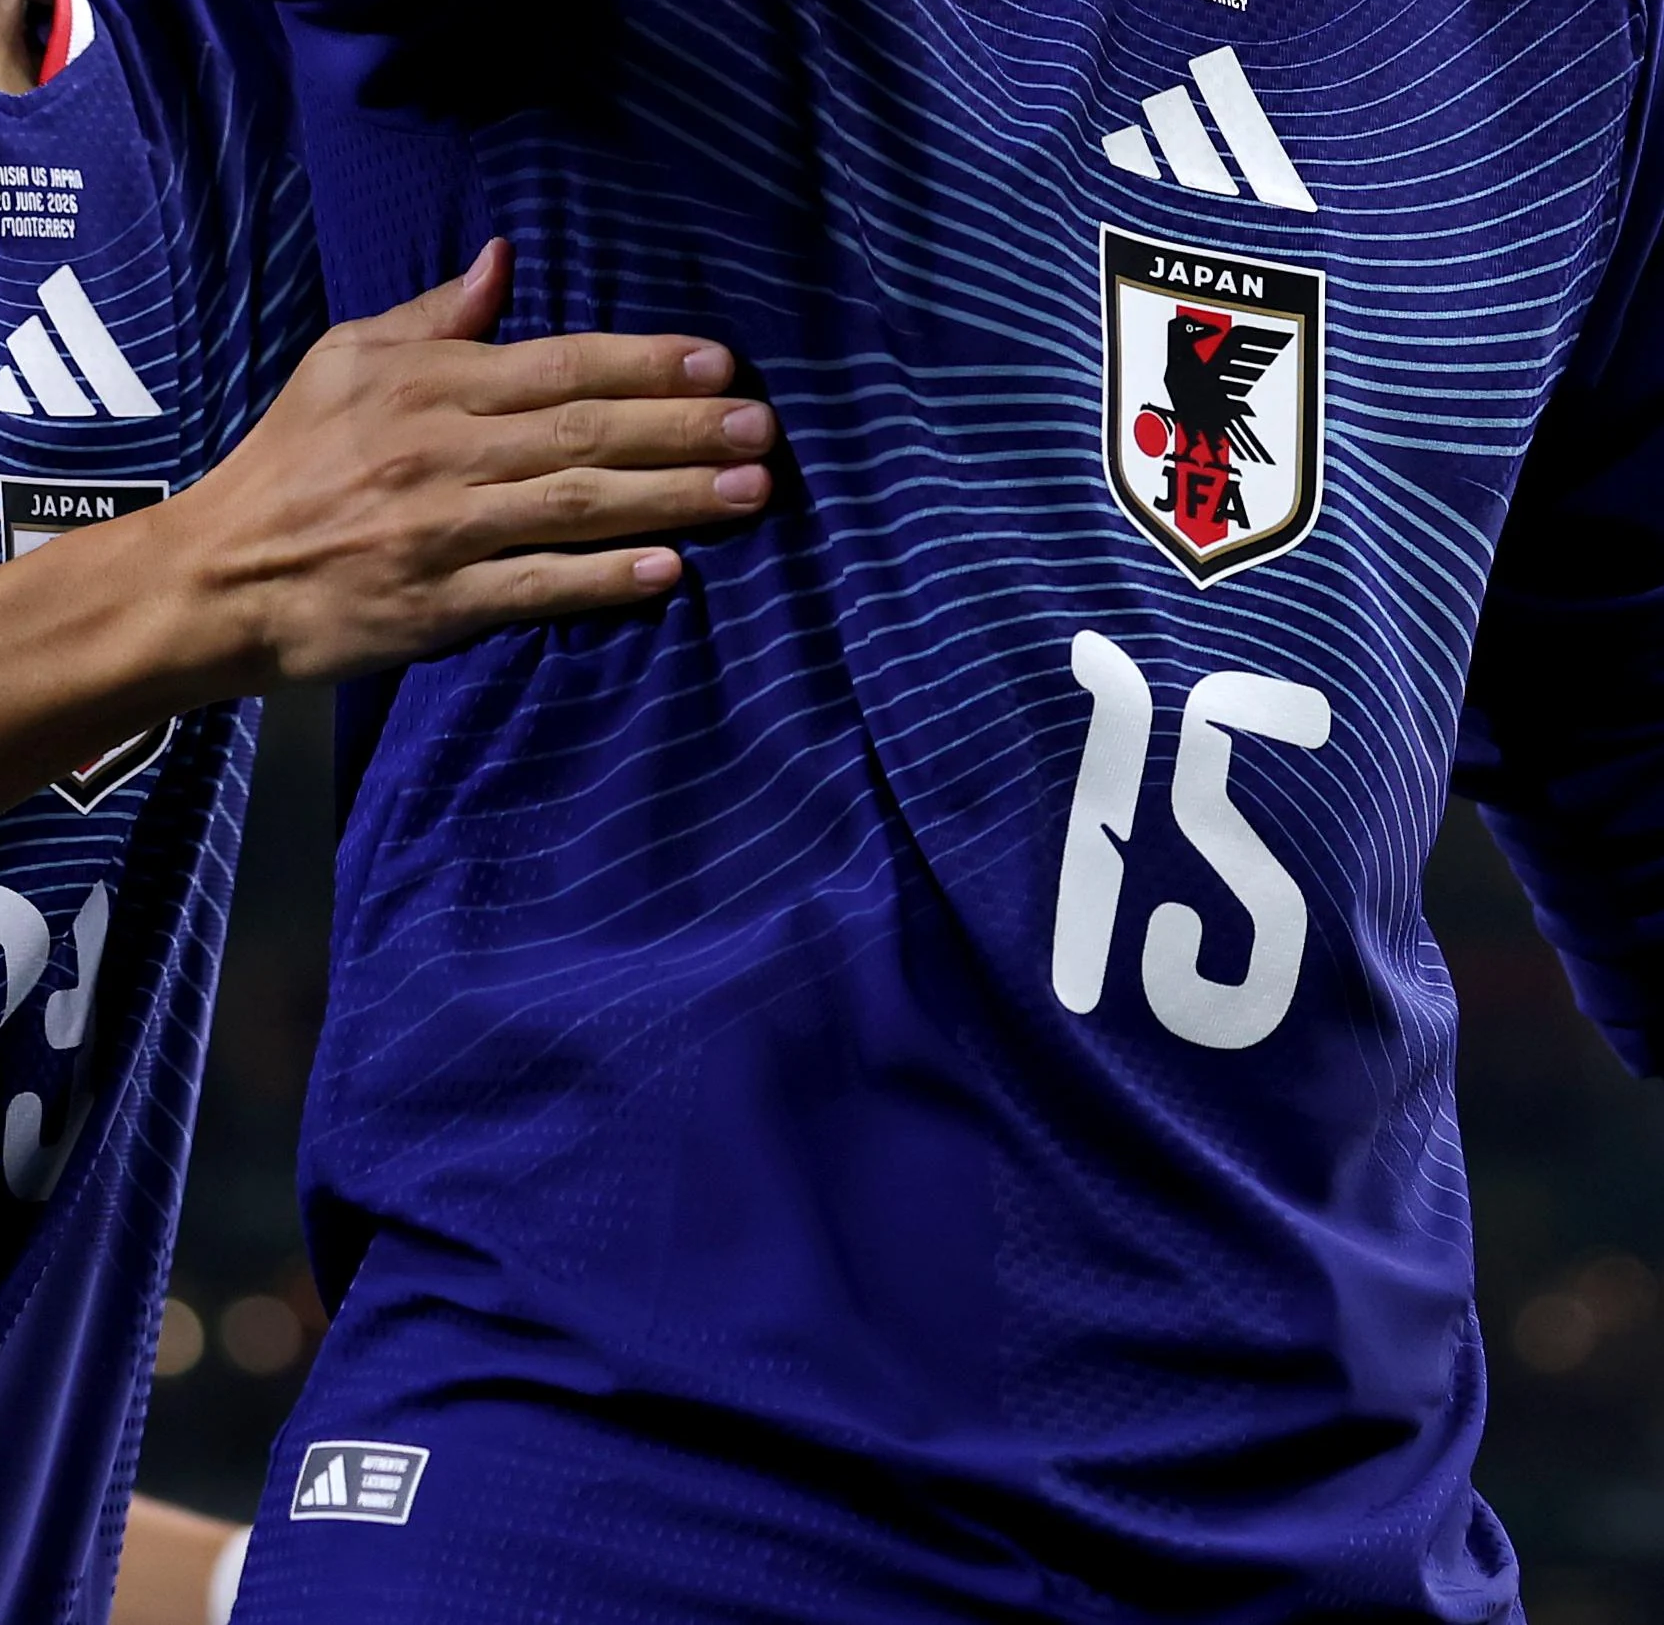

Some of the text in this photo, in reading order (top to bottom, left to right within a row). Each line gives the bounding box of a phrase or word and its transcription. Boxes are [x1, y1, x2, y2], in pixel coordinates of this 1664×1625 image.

[49, 167, 84, 190] JAPAN
[15, 191, 44, 213] JUNE
[47, 193, 79, 214] 2026
[1, 216, 76, 239] MONTERREY
[1149, 256, 1264, 299] JAPAN
[30, 493, 115, 519] JAPAN
[1153, 466, 1251, 529] JFA
[1052, 629, 1331, 1050] 15
